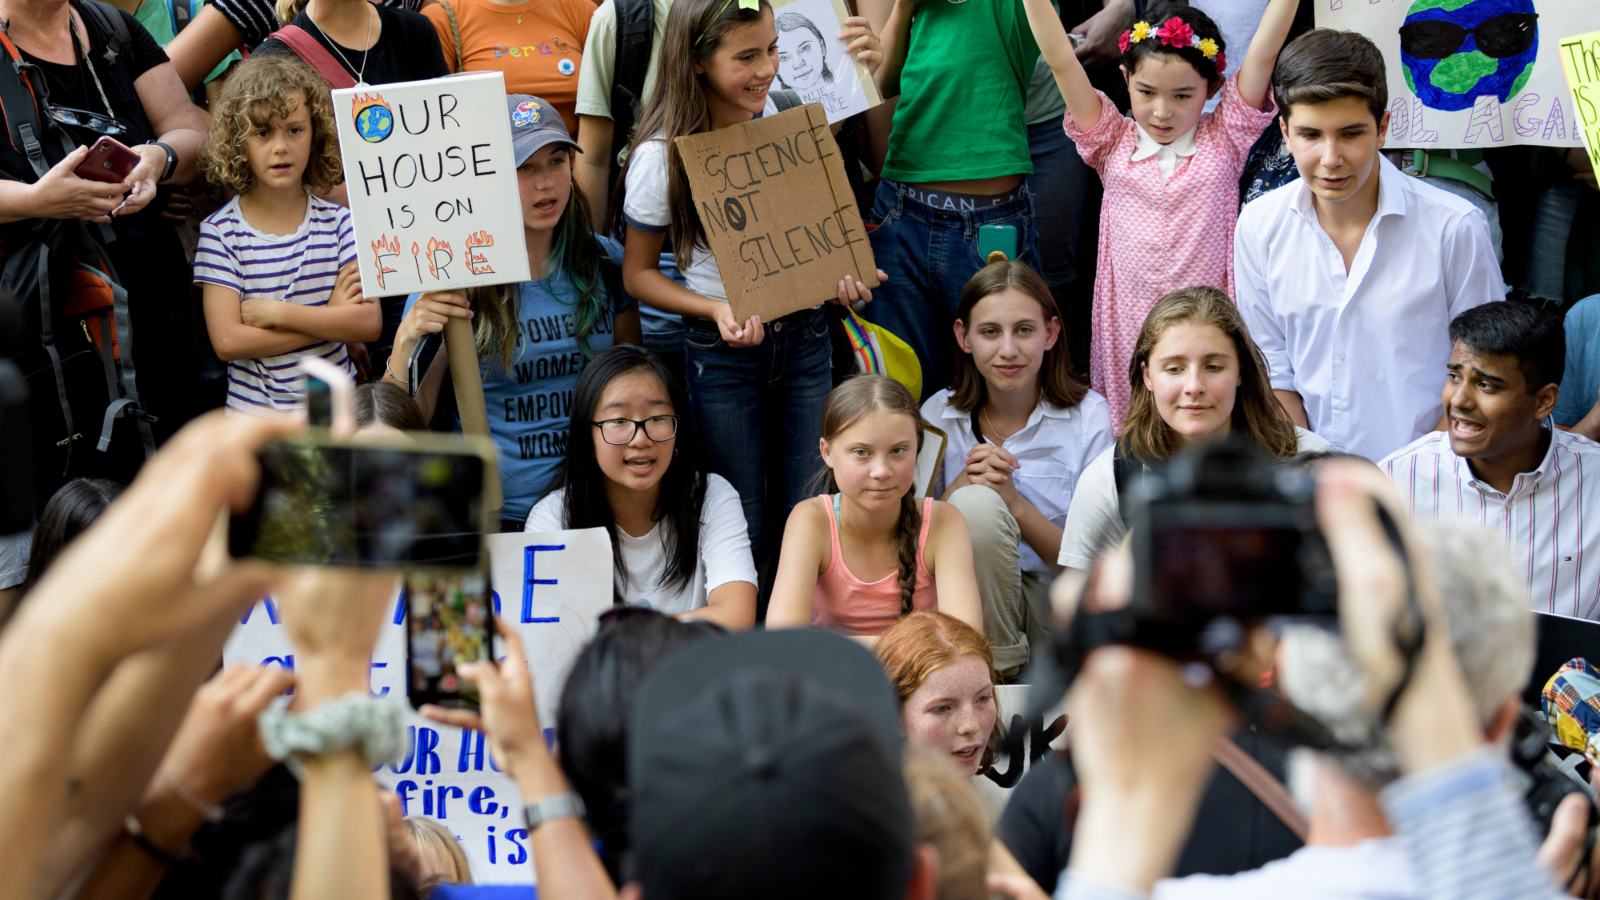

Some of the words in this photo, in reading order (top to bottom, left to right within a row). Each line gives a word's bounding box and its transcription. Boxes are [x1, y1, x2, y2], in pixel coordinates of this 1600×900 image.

[352, 93, 460, 143] OUR
[1386, 92, 1438, 142] OL
[1573, 85, 1597, 126] IS
[358, 143, 496, 196] HOUSE
[705, 124, 834, 193] SCIENCE
[387, 205, 415, 229] IS
[435, 197, 473, 222] ON
[702, 190, 760, 238] NOT
[371, 230, 495, 290] FIRE
[739, 204, 864, 281] SILENCE
[396, 779, 509, 819] fire,
[487, 826, 530, 865] is
